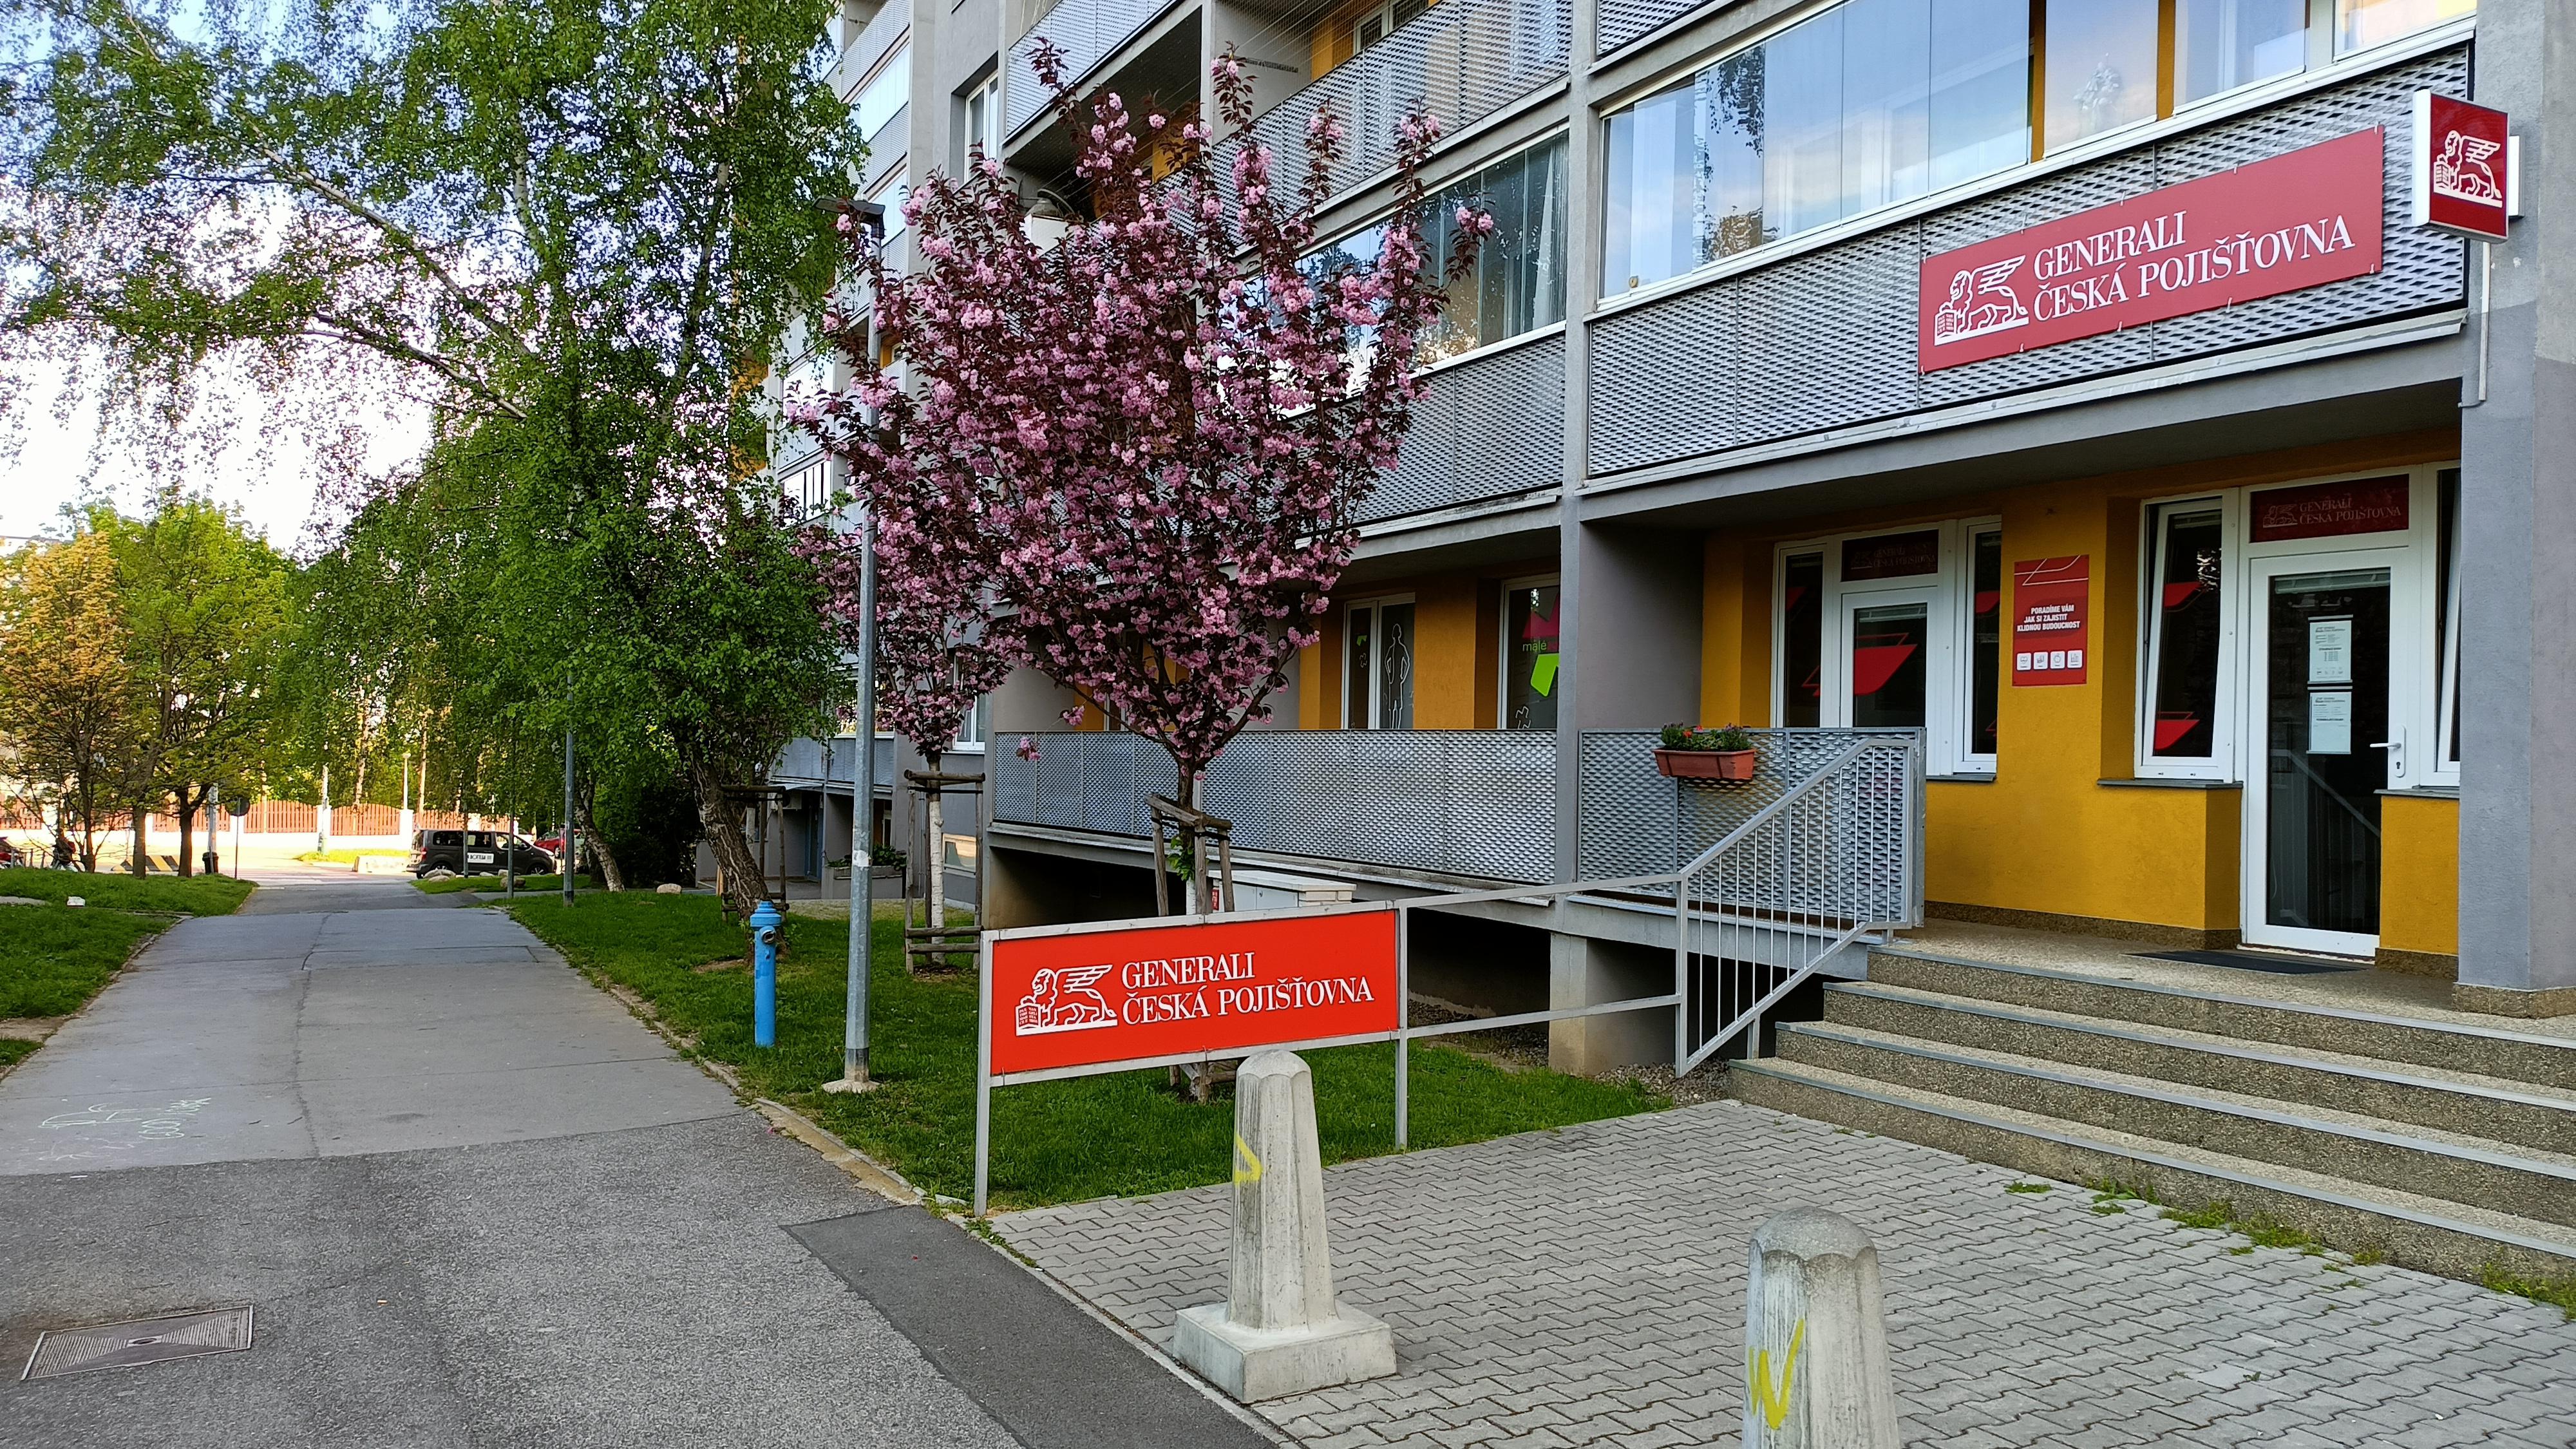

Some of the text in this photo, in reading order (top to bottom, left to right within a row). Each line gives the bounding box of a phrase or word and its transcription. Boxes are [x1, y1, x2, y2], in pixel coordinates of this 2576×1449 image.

[2034, 210, 2188, 281] GENERALI
[2034, 215, 2356, 321] ČESKÁ POJIŠŤOVNA
[2300, 498, 2353, 513] GENERALI
[2031, 603, 2074, 614] PORADÍME VÁM
[2043, 621, 2080, 630] BUDOUCNOST
[1122, 952, 1255, 989] GENERALI
[1122, 976, 1374, 1025] ČESKÁ POJIŠŤOVNA
